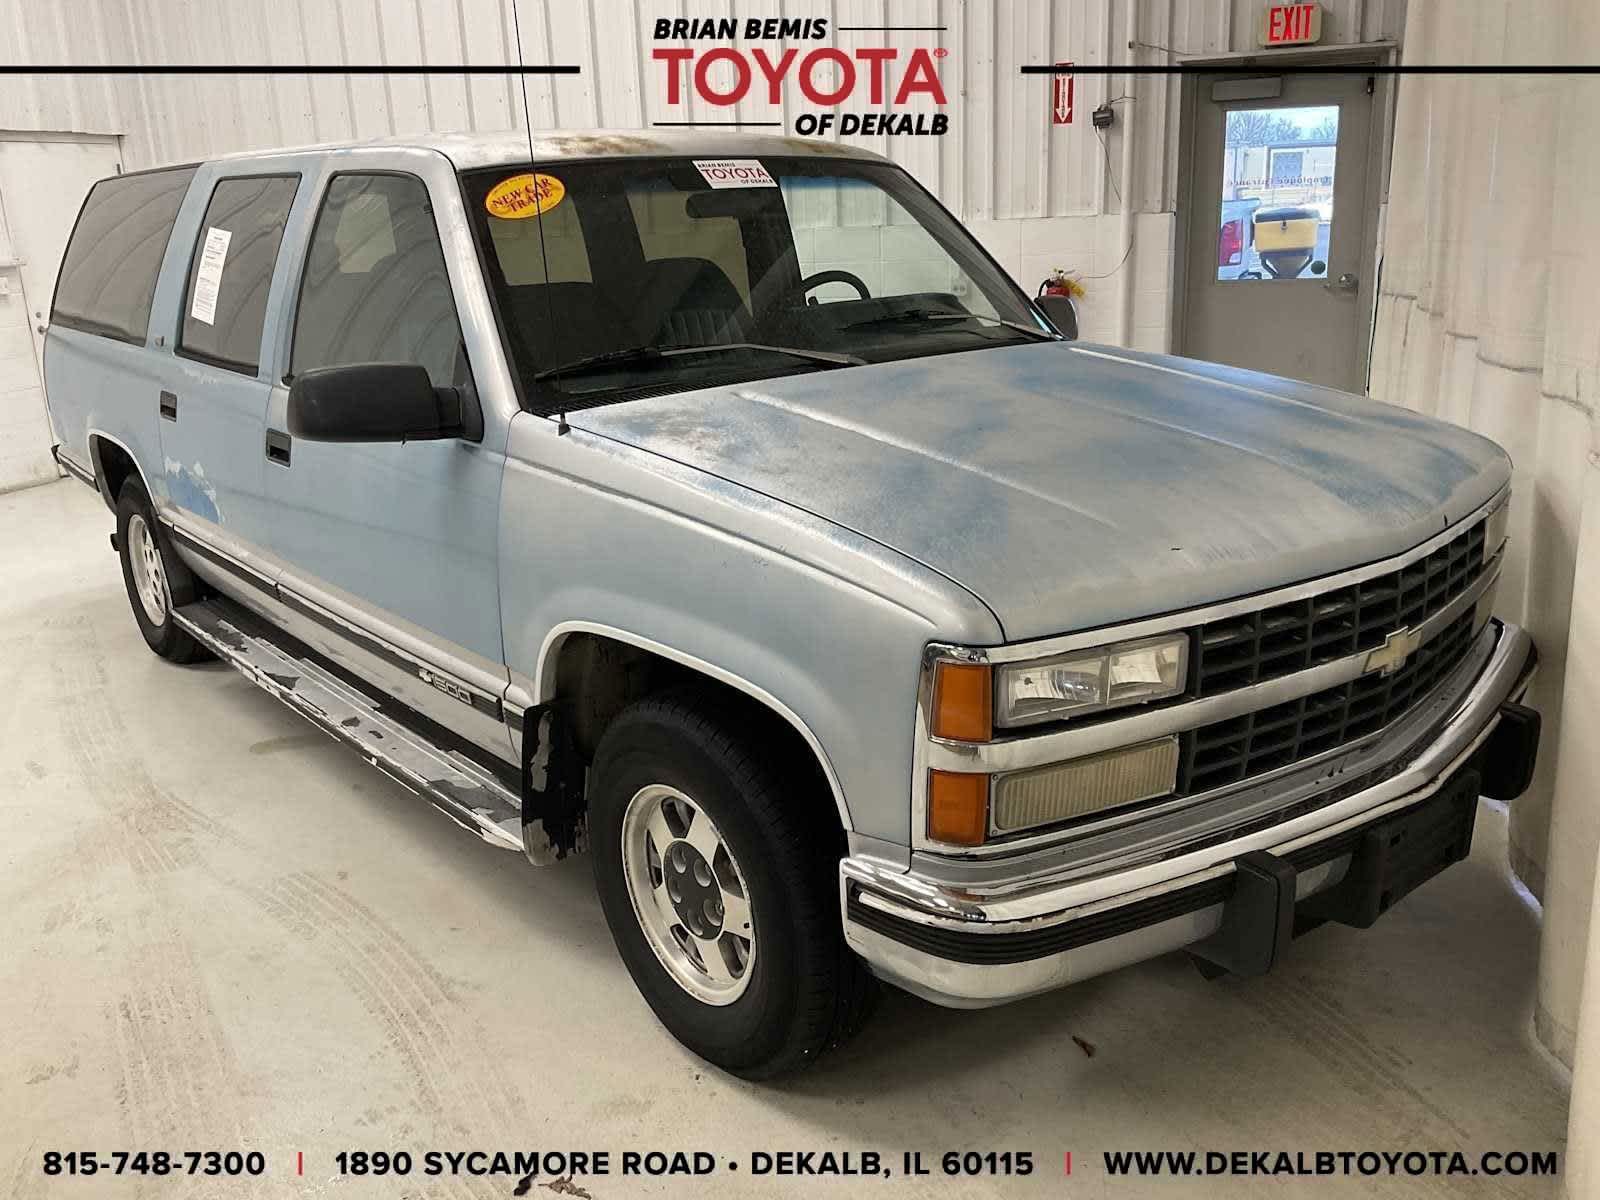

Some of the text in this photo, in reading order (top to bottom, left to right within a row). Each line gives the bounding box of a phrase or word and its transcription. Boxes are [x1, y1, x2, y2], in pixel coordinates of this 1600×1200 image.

[1268, 5, 1313, 42] EXIT
[700, 167, 769, 180] TOYOTA
[492, 188, 522, 208] NEW
[524, 178, 552, 194] CAR
[507, 188, 553, 212] TRADE
